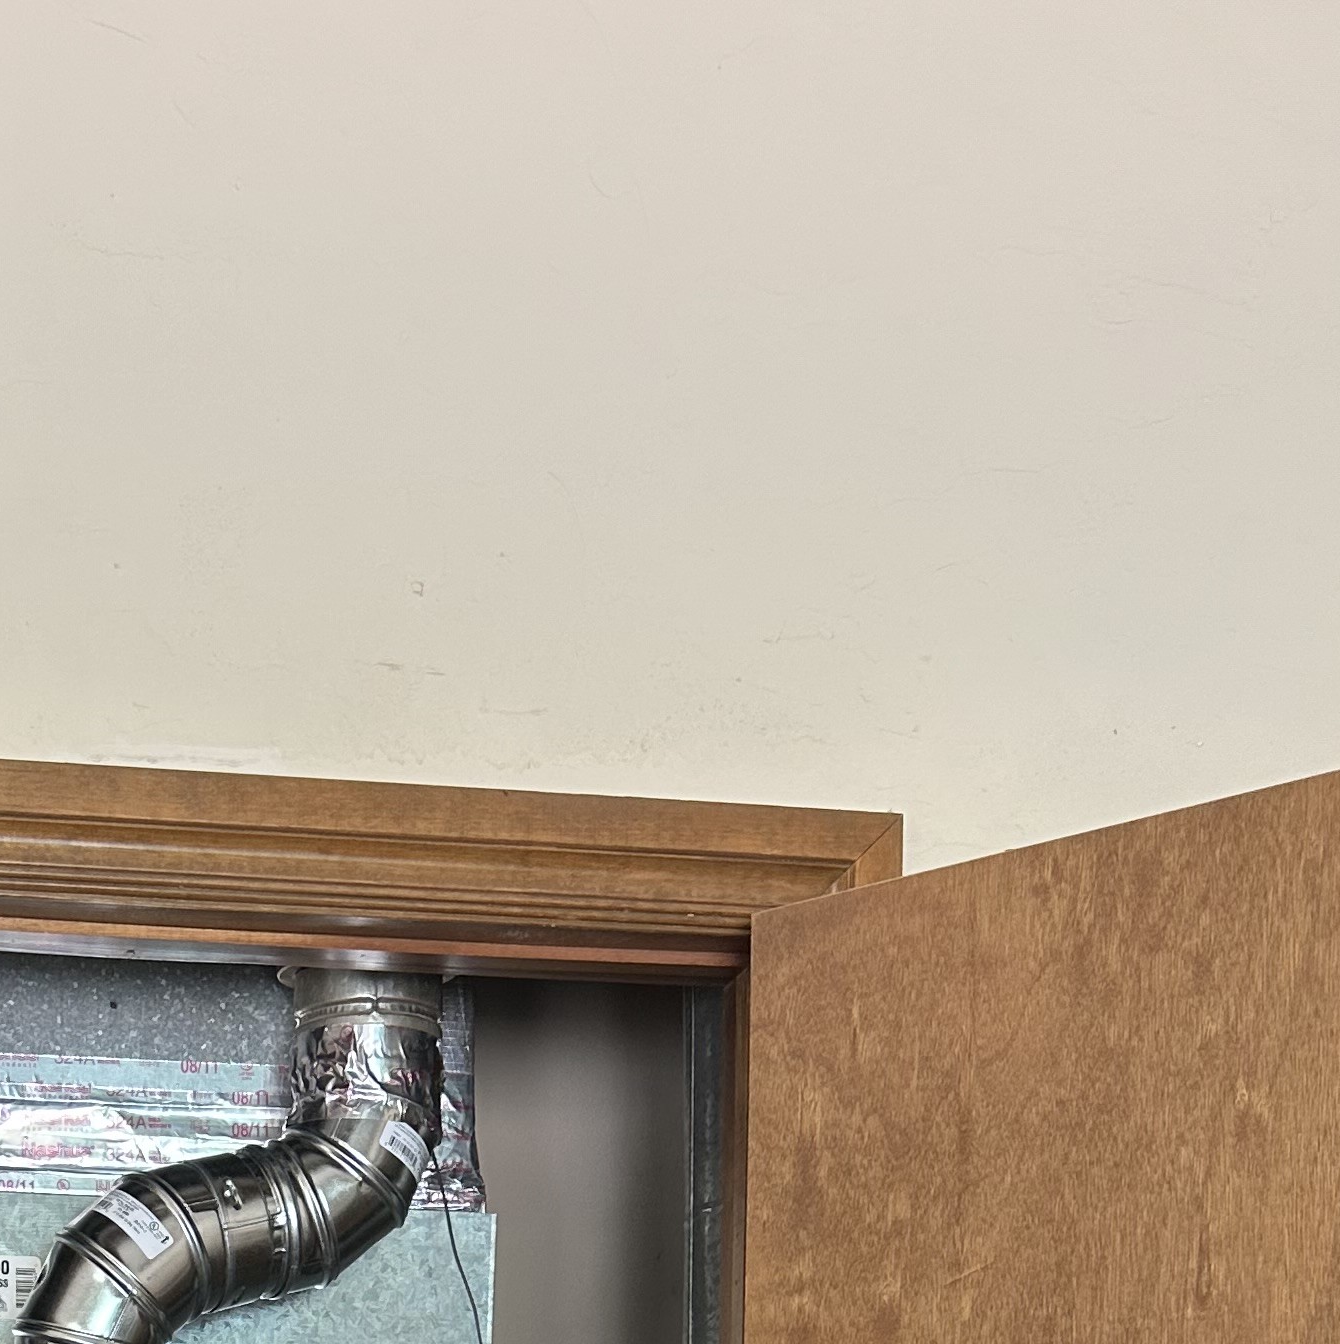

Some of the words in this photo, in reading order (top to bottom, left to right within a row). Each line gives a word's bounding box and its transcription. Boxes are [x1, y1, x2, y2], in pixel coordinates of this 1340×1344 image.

[180, 1059, 218, 1074] 08/11
[231, 1090, 269, 1105] 08/11
[231, 1122, 269, 1138] 08/11
